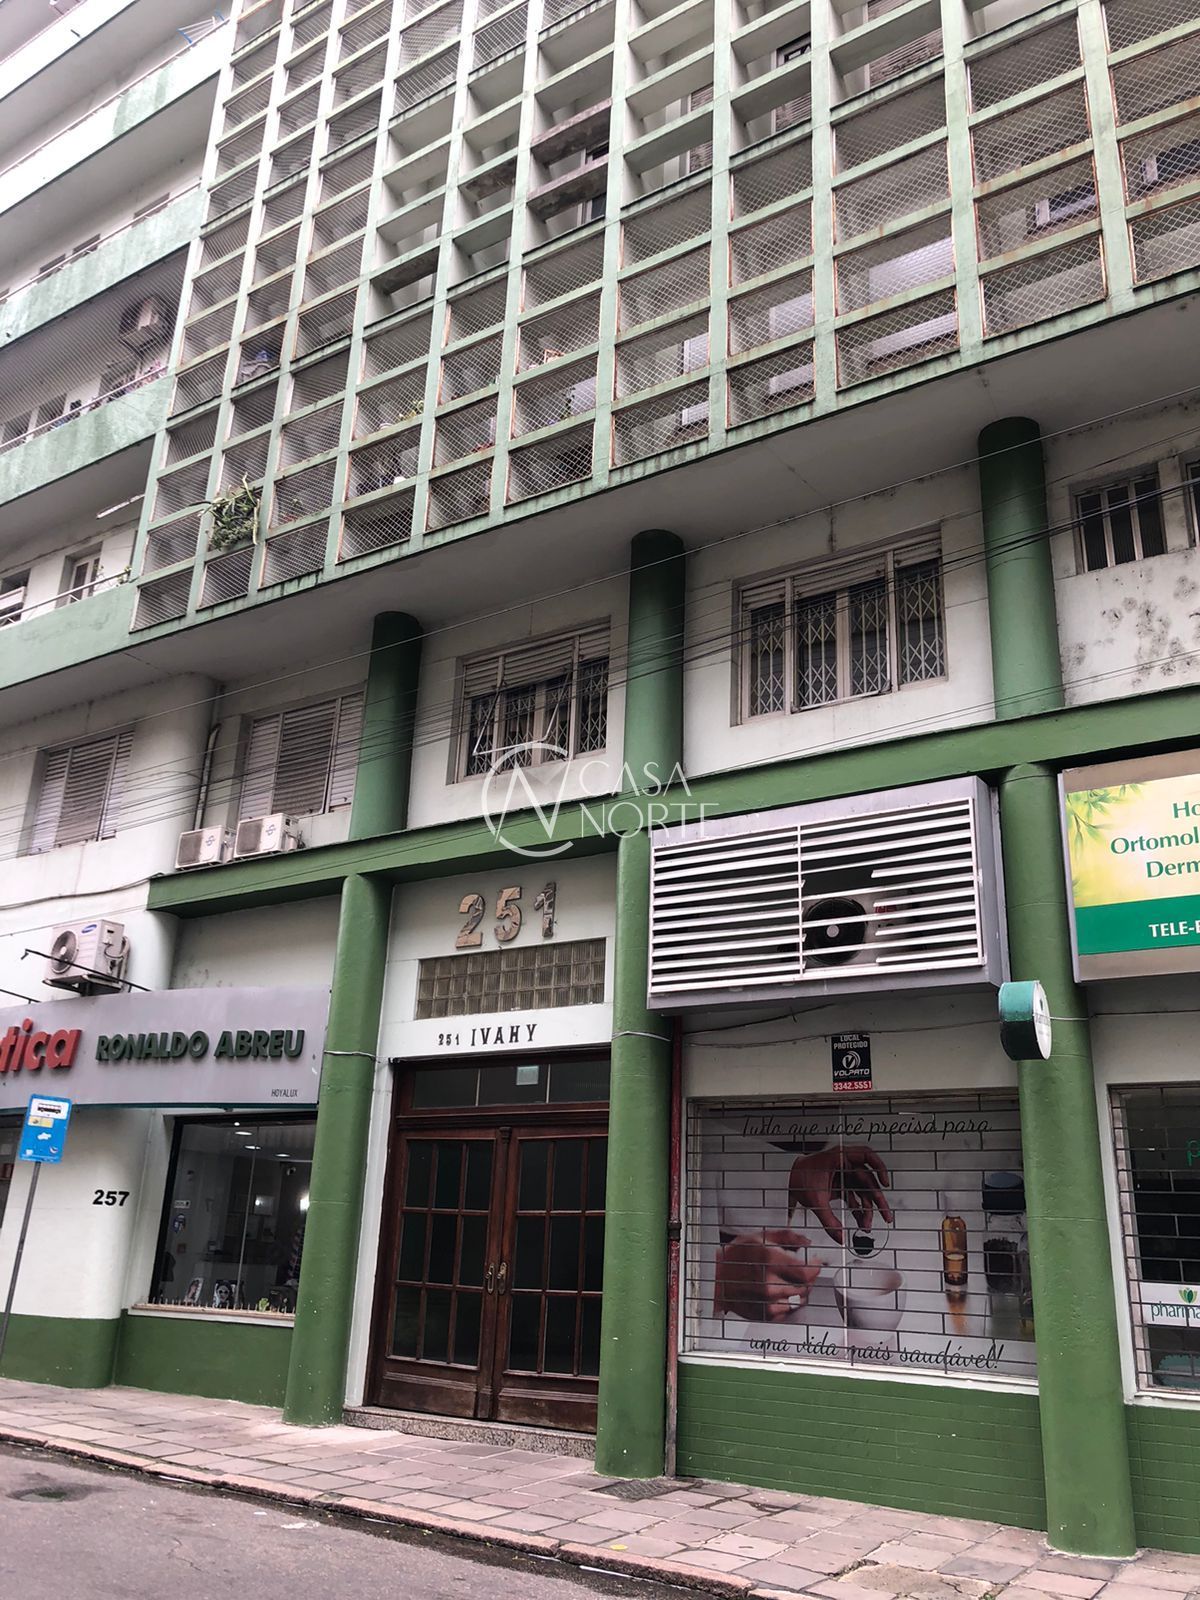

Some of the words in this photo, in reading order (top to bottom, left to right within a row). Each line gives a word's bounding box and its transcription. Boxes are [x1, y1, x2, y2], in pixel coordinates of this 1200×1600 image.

[1110, 826, 1200, 855] Ortomol
[455, 881, 557, 949] 251
[95, 1030, 210, 1061] RONALDO
[213, 1029, 305, 1059] ABREU
[438, 1033, 460, 1047] 251
[470, 1023, 538, 1047] IVAHY
[833, 1041, 868, 1050] PROTEGIDO
[840, 1034, 860, 1042] LOCAL
[833, 1068, 870, 1077] VOLPATO
[271, 1088, 298, 1098] HOYALUX
[833, 1080, 872, 1091] 3342.5551
[788, 1122, 819, 1142] que
[867, 1116, 937, 1141] precisa
[942, 1119, 990, 1141] para
[92, 1189, 130, 1207] 257
[749, 1337, 791, 1353] uma
[796, 1331, 840, 1356] vida
[899, 1339, 1004, 1369] saudável!
